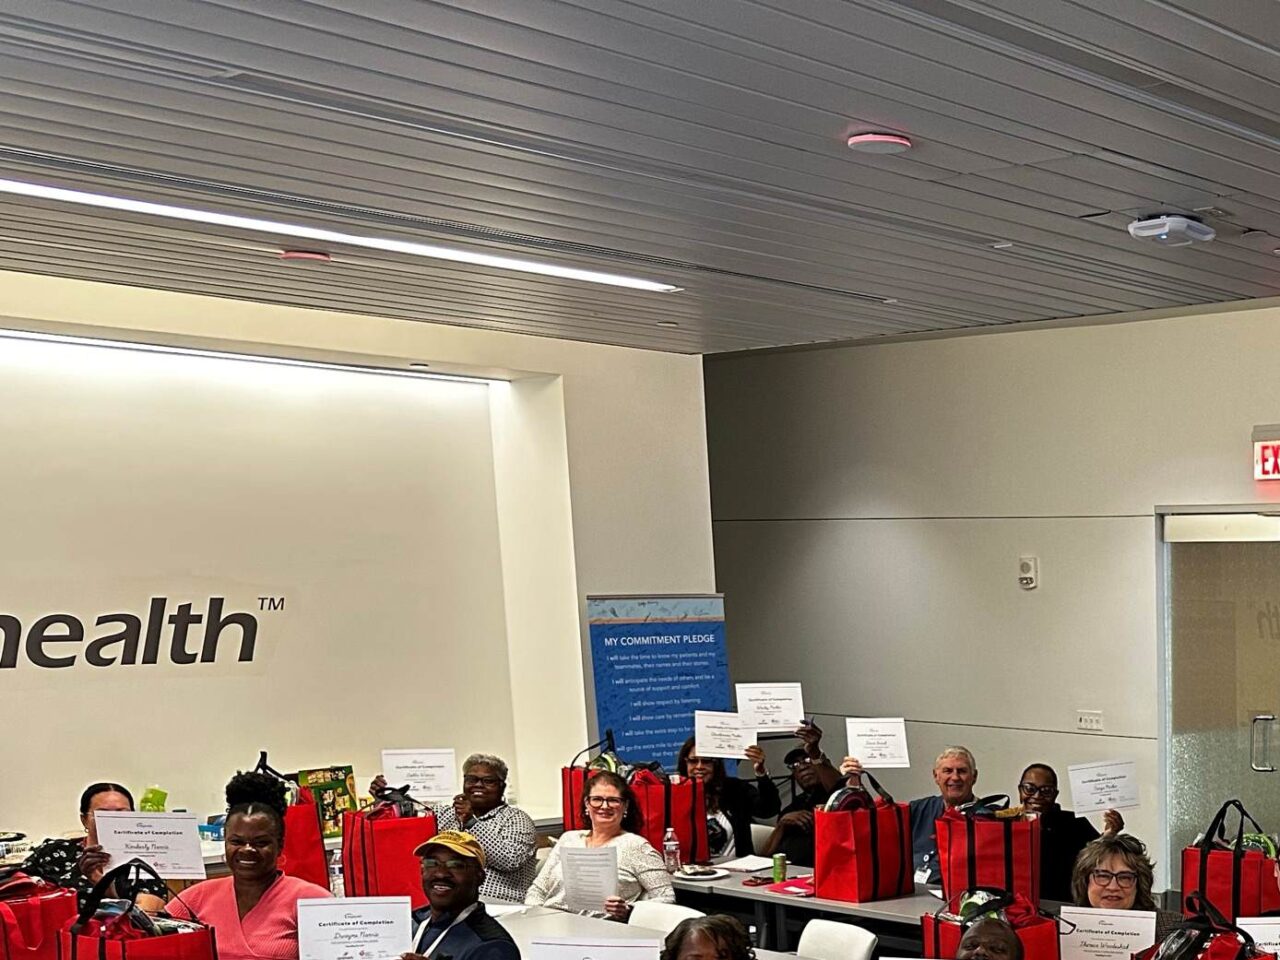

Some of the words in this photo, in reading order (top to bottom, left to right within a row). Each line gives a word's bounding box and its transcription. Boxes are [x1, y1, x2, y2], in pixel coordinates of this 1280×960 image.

[258, 597, 285, 610] TM
[604, 637, 618, 647] MY
[620, 635, 682, 646] COMMITMENT
[683, 634, 715, 643] PLEDGE
